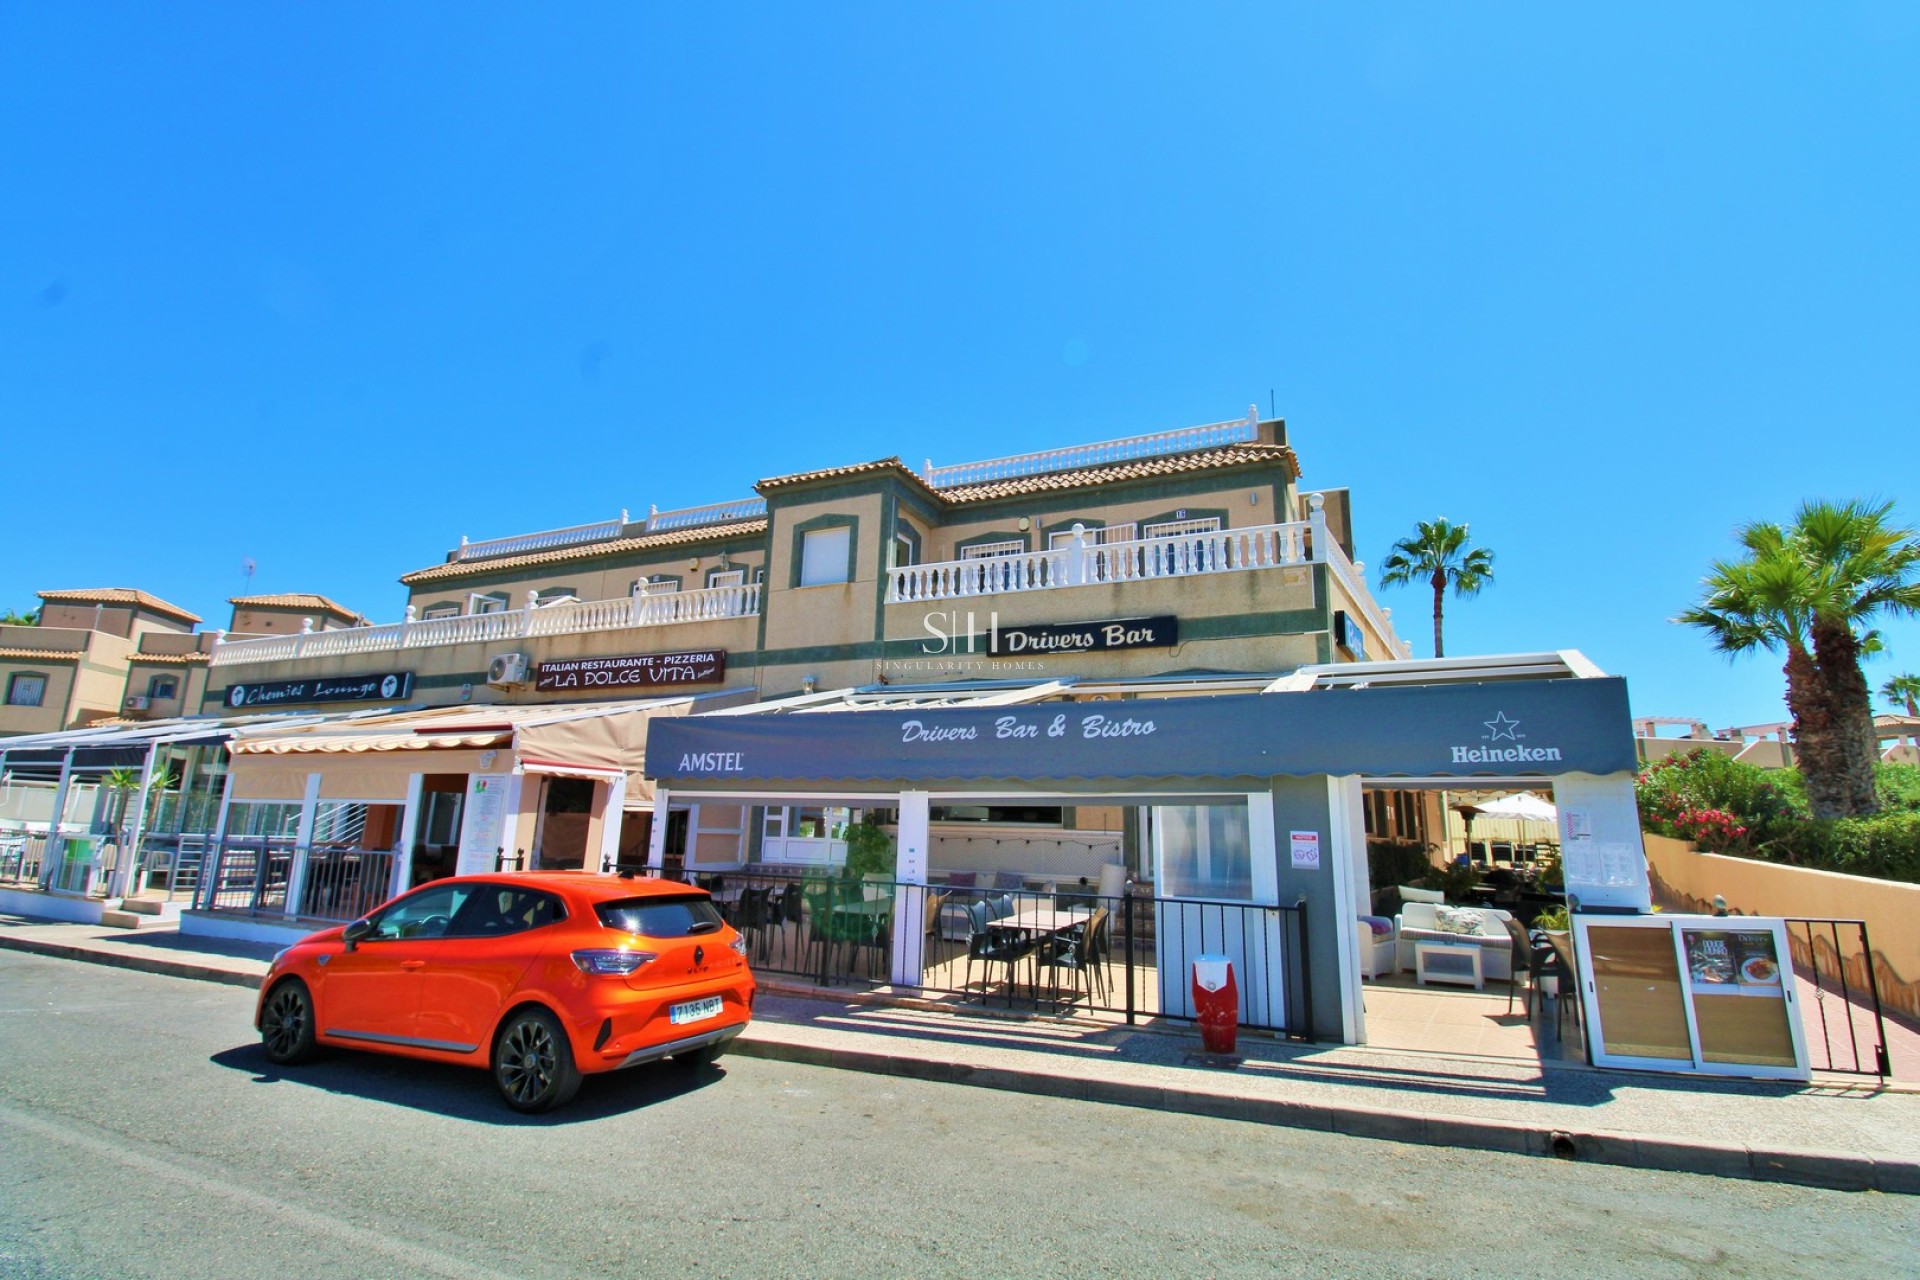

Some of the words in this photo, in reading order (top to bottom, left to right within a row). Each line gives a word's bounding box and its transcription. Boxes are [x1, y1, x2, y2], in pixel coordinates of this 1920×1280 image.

[1005, 631, 1095, 652] Drivers
[1101, 624, 1156, 647] Bar
[542, 663, 578, 673] ITALIAN
[581, 657, 654, 671] RESTAURANTE
[664, 653, 715, 665] PIZZERIA
[555, 673, 578, 687] LA
[584, 669, 641, 686] DOLCE
[648, 665, 696, 683] VITA
[313, 682, 377, 699] Lounge
[901, 720, 979, 743] Drivers
[994, 715, 1040, 739] Bar
[1047, 714, 1066, 738] &
[1081, 714, 1157, 739] Bistro
[678, 752, 744, 771] AMSTEL
[1450, 744, 1562, 763] Heineken
[677, 1003, 700, 1018] 7135
[703, 998, 720, 1013] NBT
